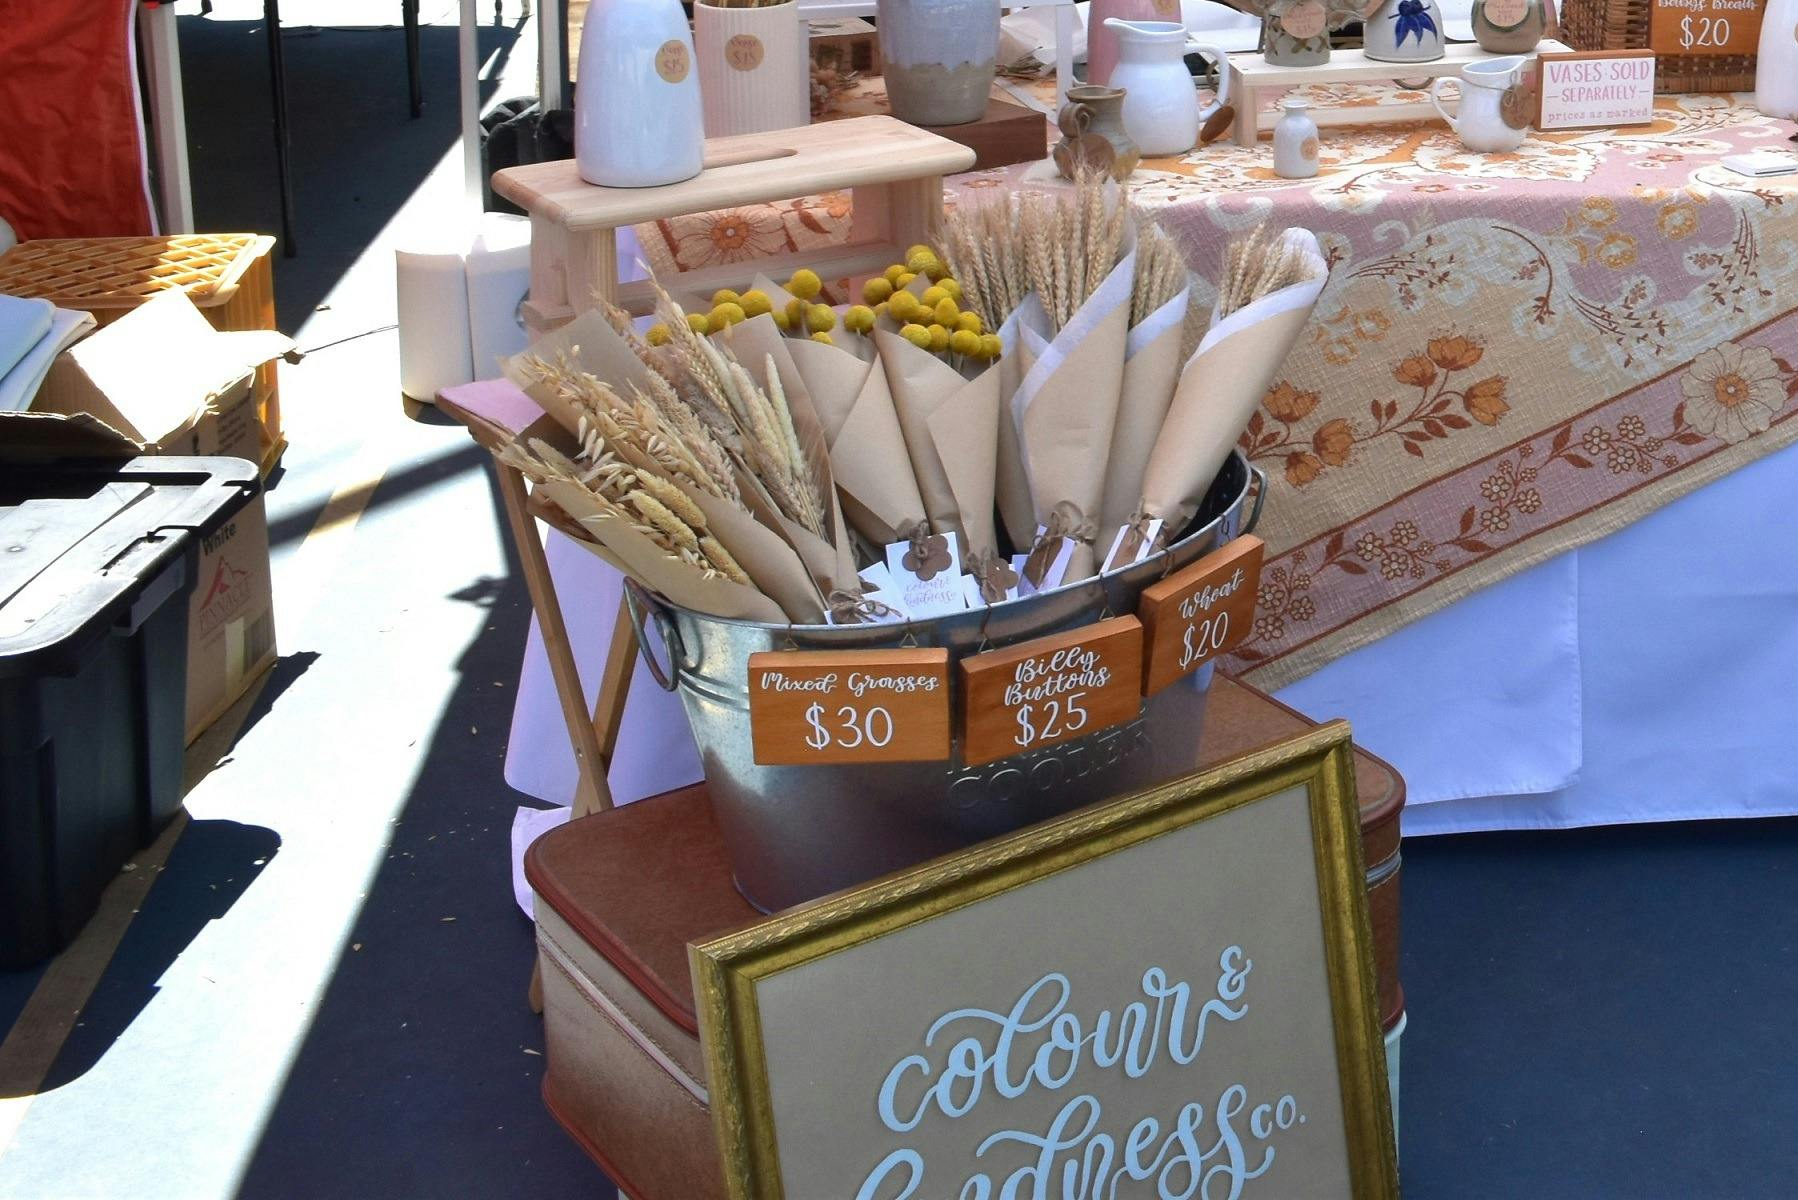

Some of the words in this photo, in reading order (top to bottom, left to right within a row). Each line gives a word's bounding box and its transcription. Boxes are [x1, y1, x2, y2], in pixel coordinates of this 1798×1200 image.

[1679, 14, 1730, 50] $20
[1550, 62, 1603, 84] VASES
[1609, 60, 1650, 81] SOLD
[1562, 85, 1637, 103] SEPARATELY
[1548, 109, 1585, 122] prices
[1589, 111, 1603, 119] as
[1607, 107, 1648, 119] marked
[202, 522, 237, 556] White
[1179, 566, 1246, 620] Wheat
[1179, 611, 1230, 670] $20
[761, 672, 838, 693] Mixed
[847, 671, 940, 692] Grasses
[1015, 646, 1101, 684] Billy
[1004, 667, 1111, 706] Buttons
[804, 701, 894, 751] $30
[1014, 692, 1088, 748] $25
[878, 966, 1248, 1132] colour
[1216, 944, 1252, 1000] &
